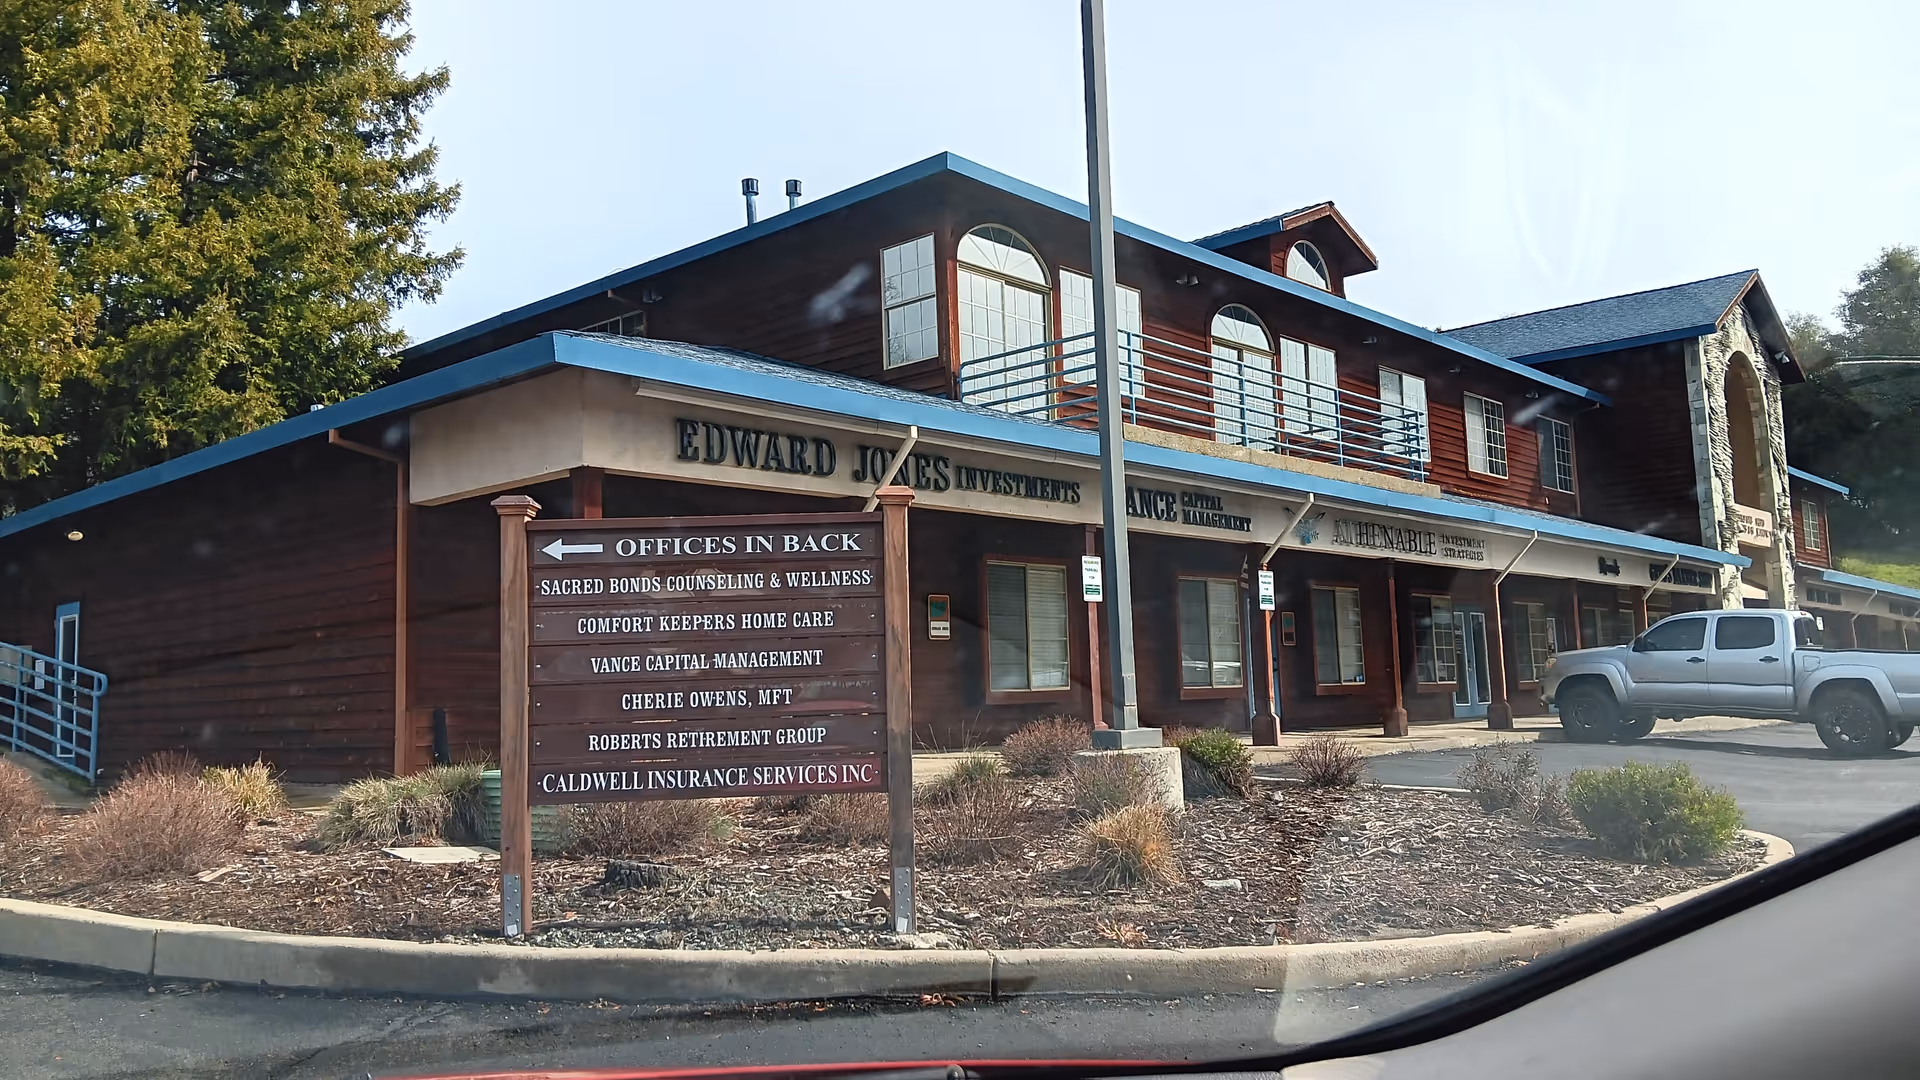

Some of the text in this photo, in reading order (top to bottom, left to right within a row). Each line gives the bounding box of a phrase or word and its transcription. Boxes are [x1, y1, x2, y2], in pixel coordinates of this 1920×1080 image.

[677, 418, 1082, 504] EDWARD JONES INVESTMENTS
[1126, 486, 1178, 522] ANCE
[1181, 491, 1224, 512] CAPITAL
[1181, 508, 1252, 533] MANAGEMENT
[615, 532, 863, 558] OFFICES IN BACK
[1440, 533, 1486, 549] INVESTMENT
[1443, 547, 1485, 562] STRATEGIES
[540, 569, 872, 597] SACRED BONDS COUNSELING & WELLNESS
[577, 610, 835, 635] COMFORT KEEPERS HOME CARE
[590, 649, 824, 674] VANCE CAPITAL MANAGEMENT
[621, 688, 793, 711] CHERIE OWENS, MFT
[588, 727, 828, 752] ROBERTS RETIREMENT GROUP
[541, 763, 874, 794] CALDWELL INSURANCE SERVICES INC
